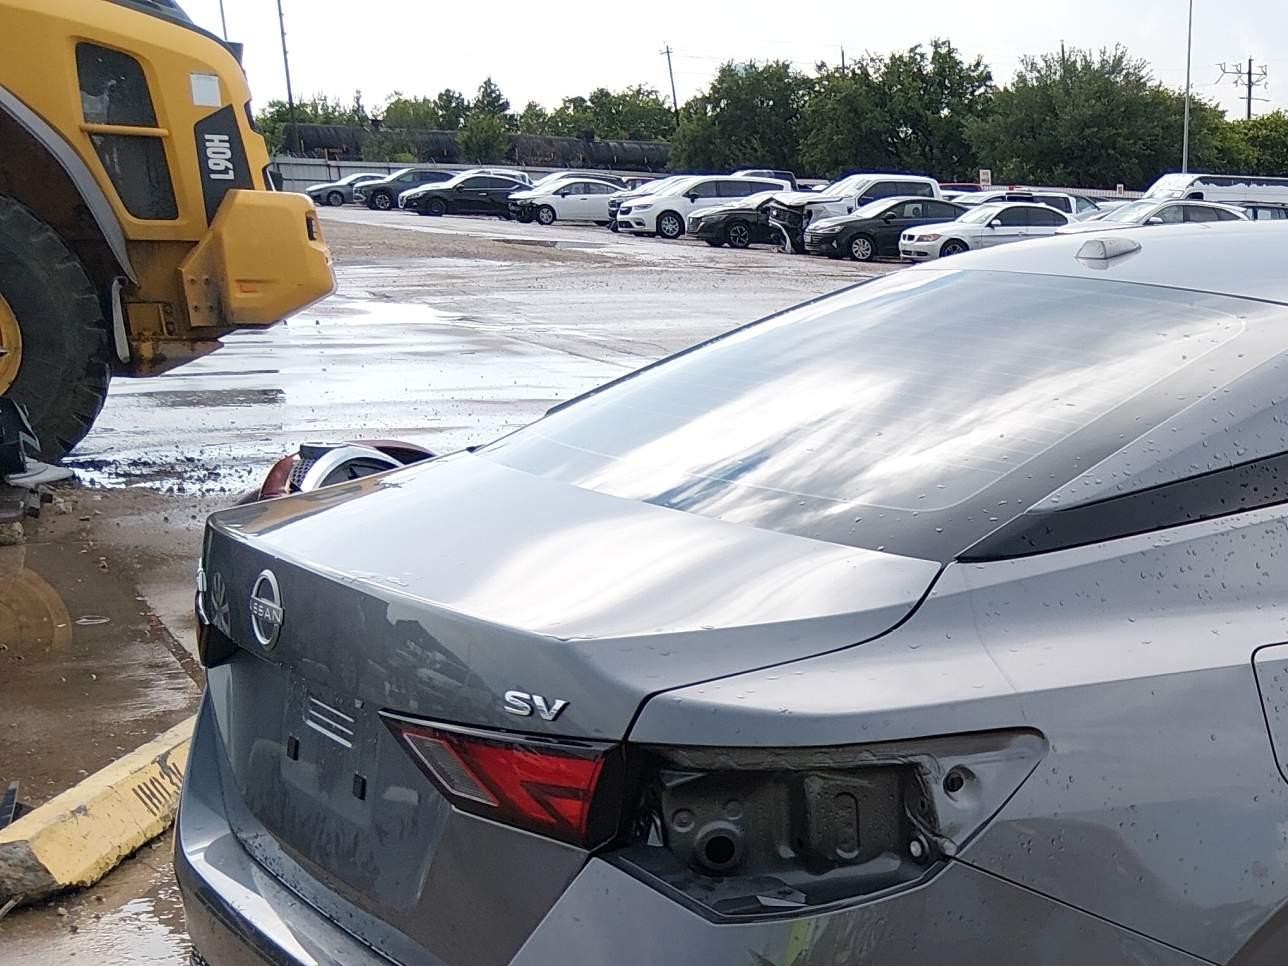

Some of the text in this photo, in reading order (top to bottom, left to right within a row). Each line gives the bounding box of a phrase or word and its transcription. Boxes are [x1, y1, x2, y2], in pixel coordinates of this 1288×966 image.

[204, 134, 235, 180] L90H
[249, 599, 281, 623] ISSAN
[503, 690, 569, 721] SV
